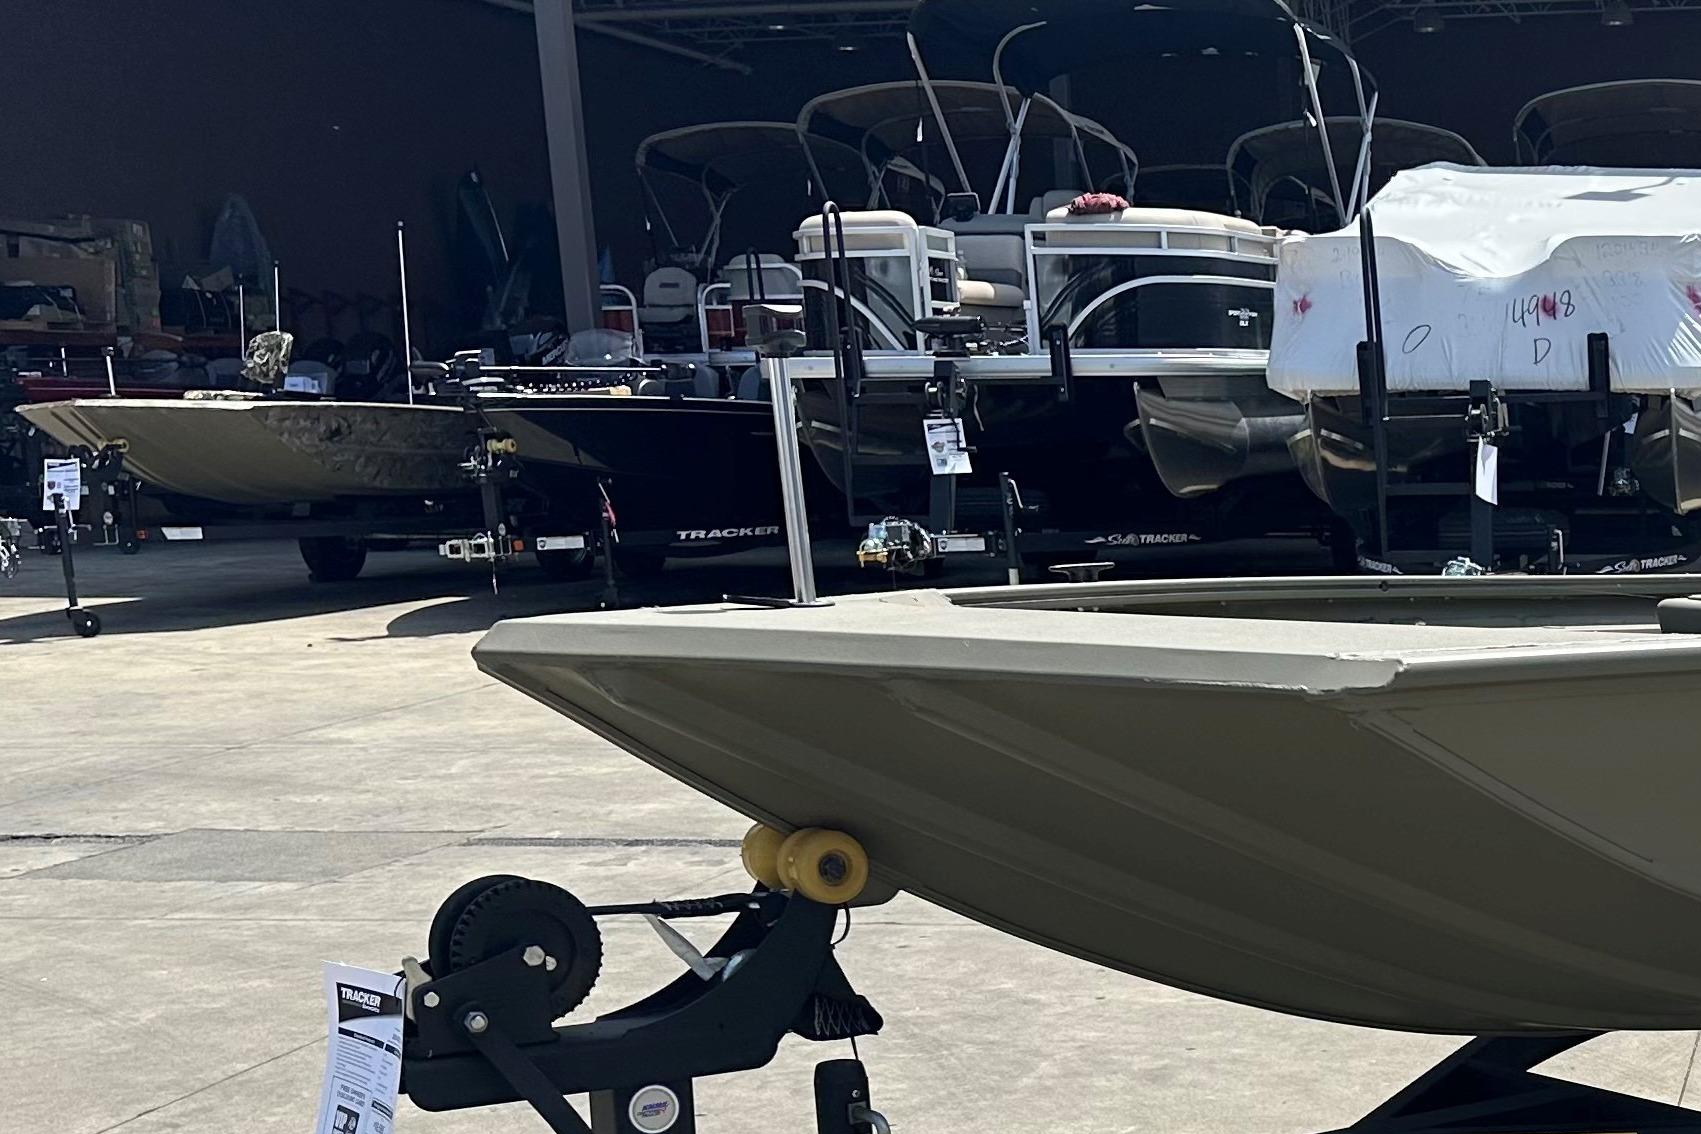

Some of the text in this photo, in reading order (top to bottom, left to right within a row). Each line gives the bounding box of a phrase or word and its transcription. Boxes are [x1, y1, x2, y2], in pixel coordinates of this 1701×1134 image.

[1512, 289, 1576, 328] 4948
[1532, 337, 1552, 366] D
[676, 526, 780, 540] TRACKER
[1139, 533, 1188, 545] TRACKER
[1640, 554, 1678, 570] TRACKER
[340, 986, 382, 1008] TRACKER
